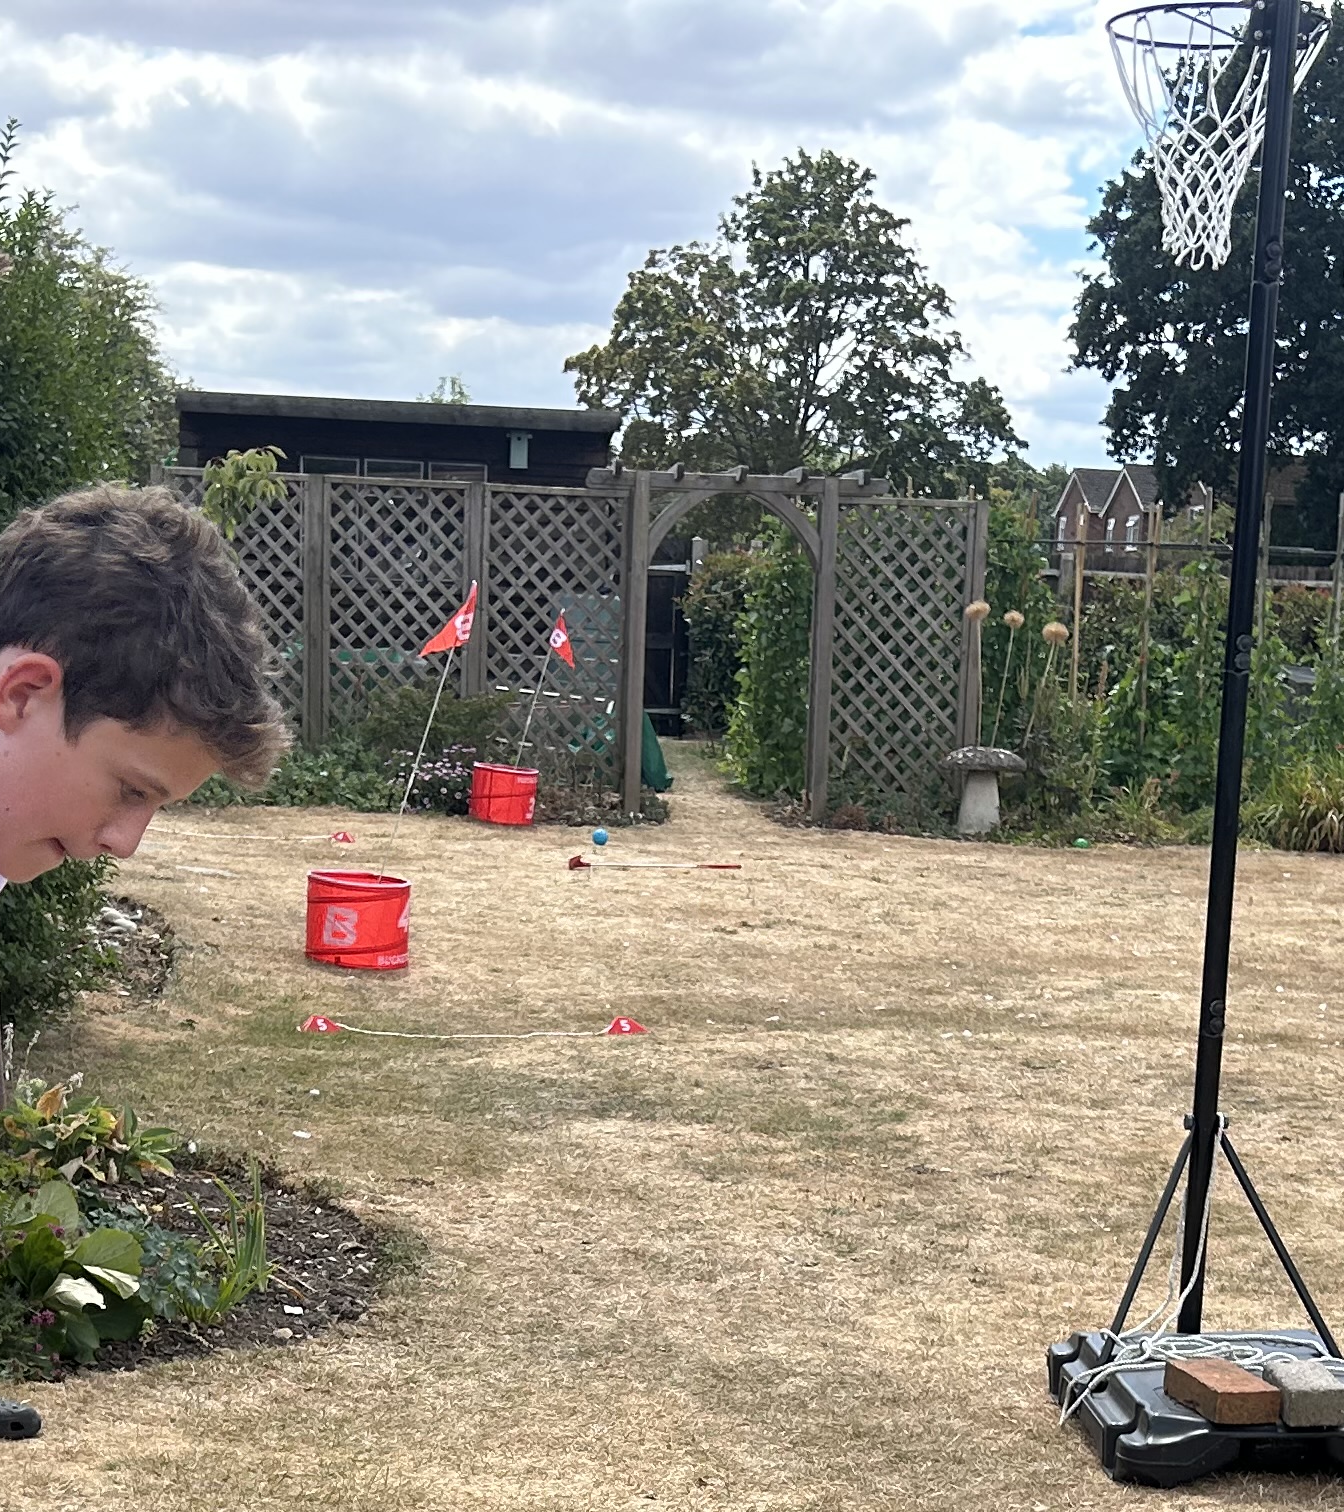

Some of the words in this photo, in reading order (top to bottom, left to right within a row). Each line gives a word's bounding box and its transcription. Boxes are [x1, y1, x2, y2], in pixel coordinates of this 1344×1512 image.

[323, 905, 358, 947] B
[317, 1018, 328, 1031] 5
[619, 1019, 631, 1032] 5
